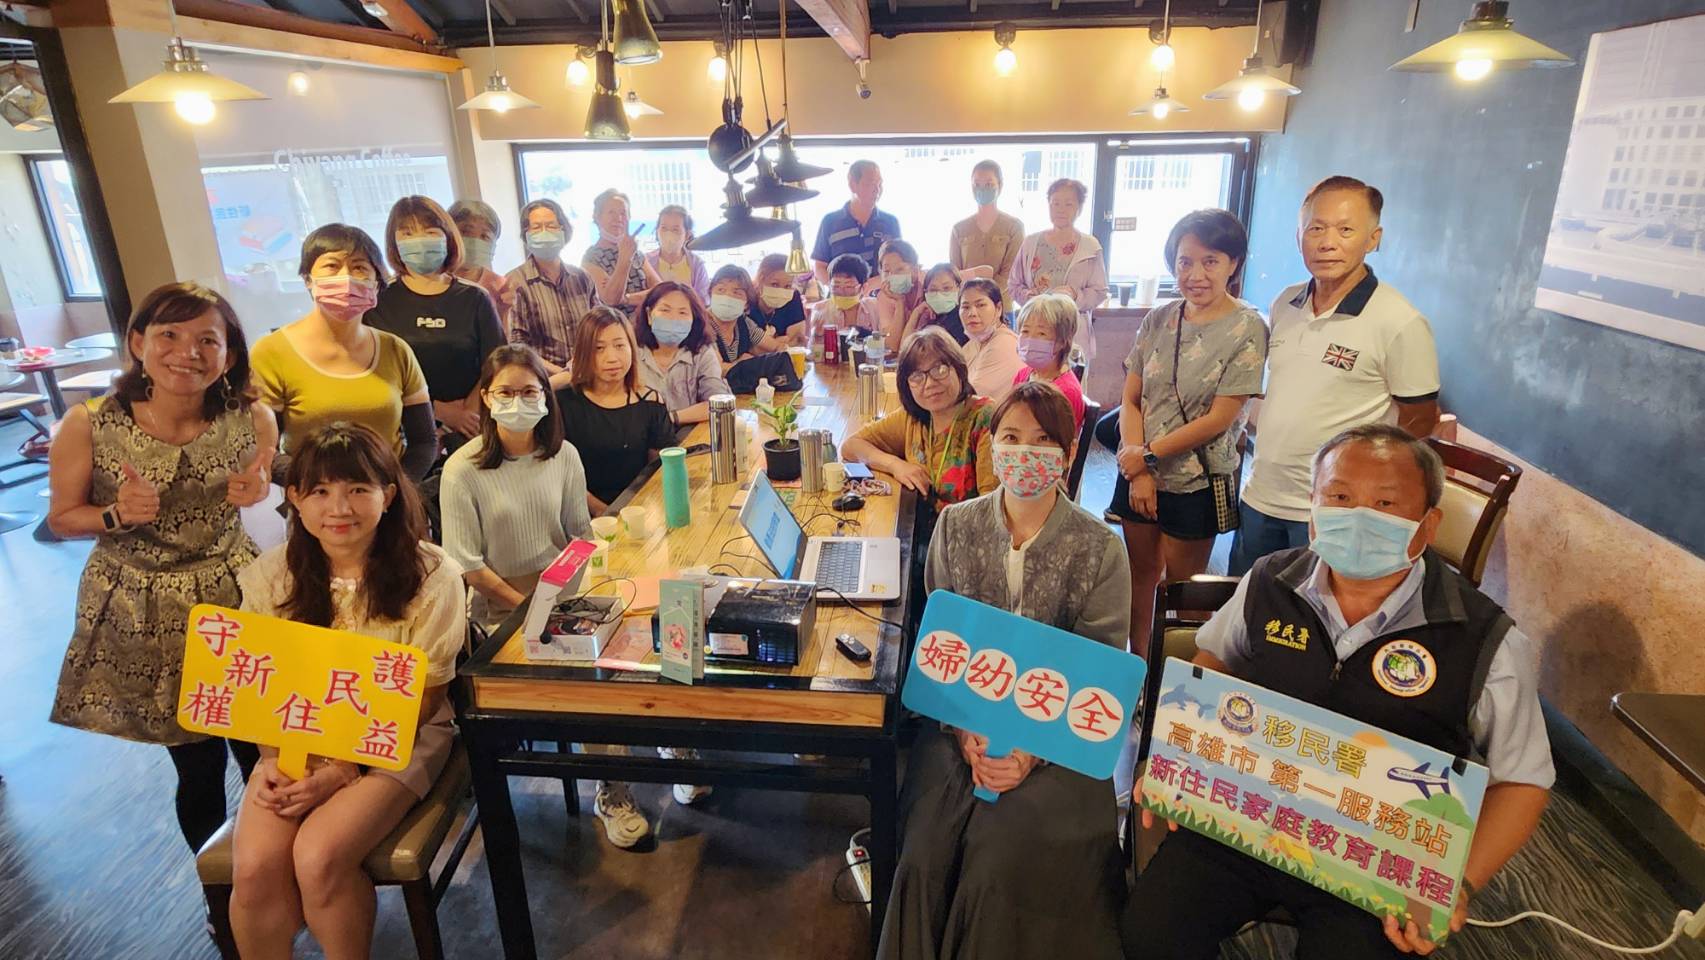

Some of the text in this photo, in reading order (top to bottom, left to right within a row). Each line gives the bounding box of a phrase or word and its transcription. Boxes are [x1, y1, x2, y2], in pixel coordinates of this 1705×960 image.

[197, 612, 417, 697] 守 護
[1265, 619, 1310, 644] 移民署
[182, 682, 399, 762] 權 益
[919, 634, 1121, 736] 婦幼安全
[1167, 720, 1452, 858] 高雄市 第一服務站
[1263, 714, 1368, 779] 移民署
[1148, 753, 1455, 908] 新住民家庭教育課程
